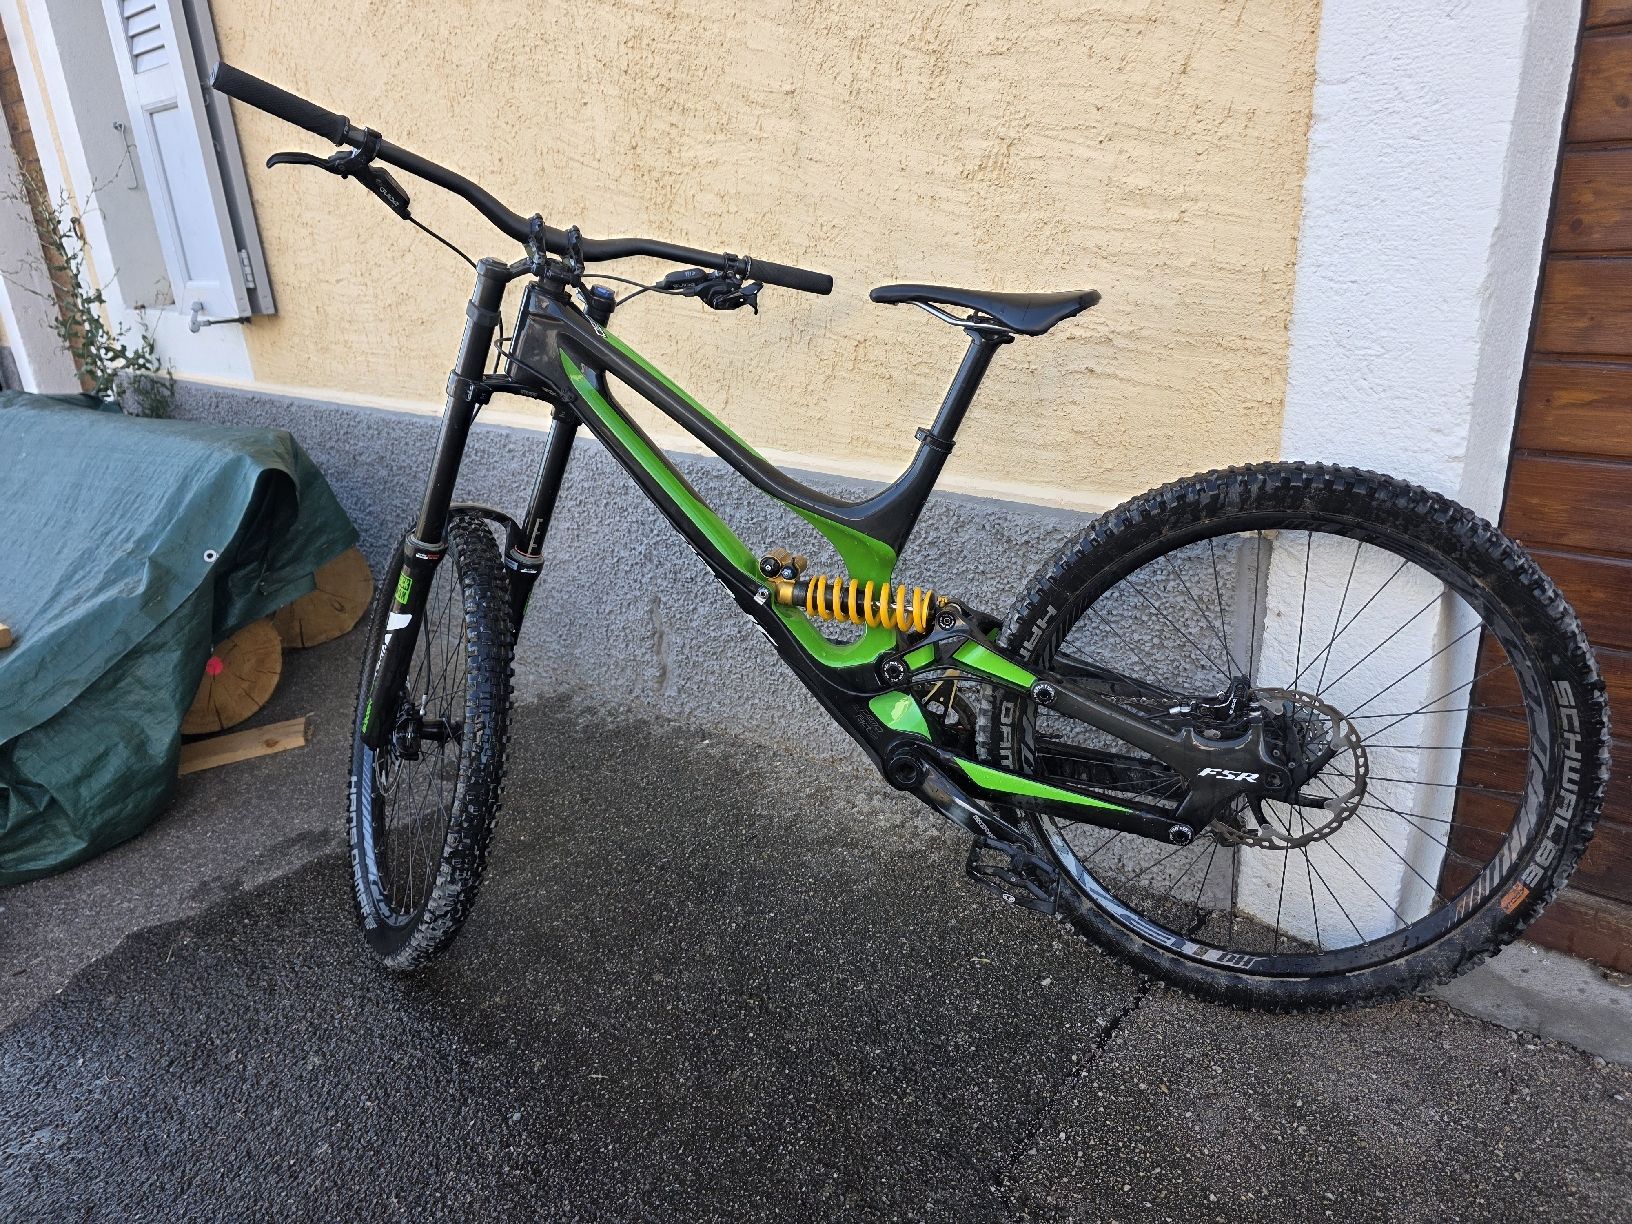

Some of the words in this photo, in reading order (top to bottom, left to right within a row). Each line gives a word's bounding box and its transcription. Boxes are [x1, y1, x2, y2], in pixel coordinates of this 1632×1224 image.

[1020, 604, 1057, 661] HA
[1000, 701, 1014, 770] DAM
[1197, 767, 1260, 783] FSR
[1521, 681, 1582, 888] SCHWALBE
[349, 776, 358, 845] HANS
[351, 849, 371, 917] DAMPF
